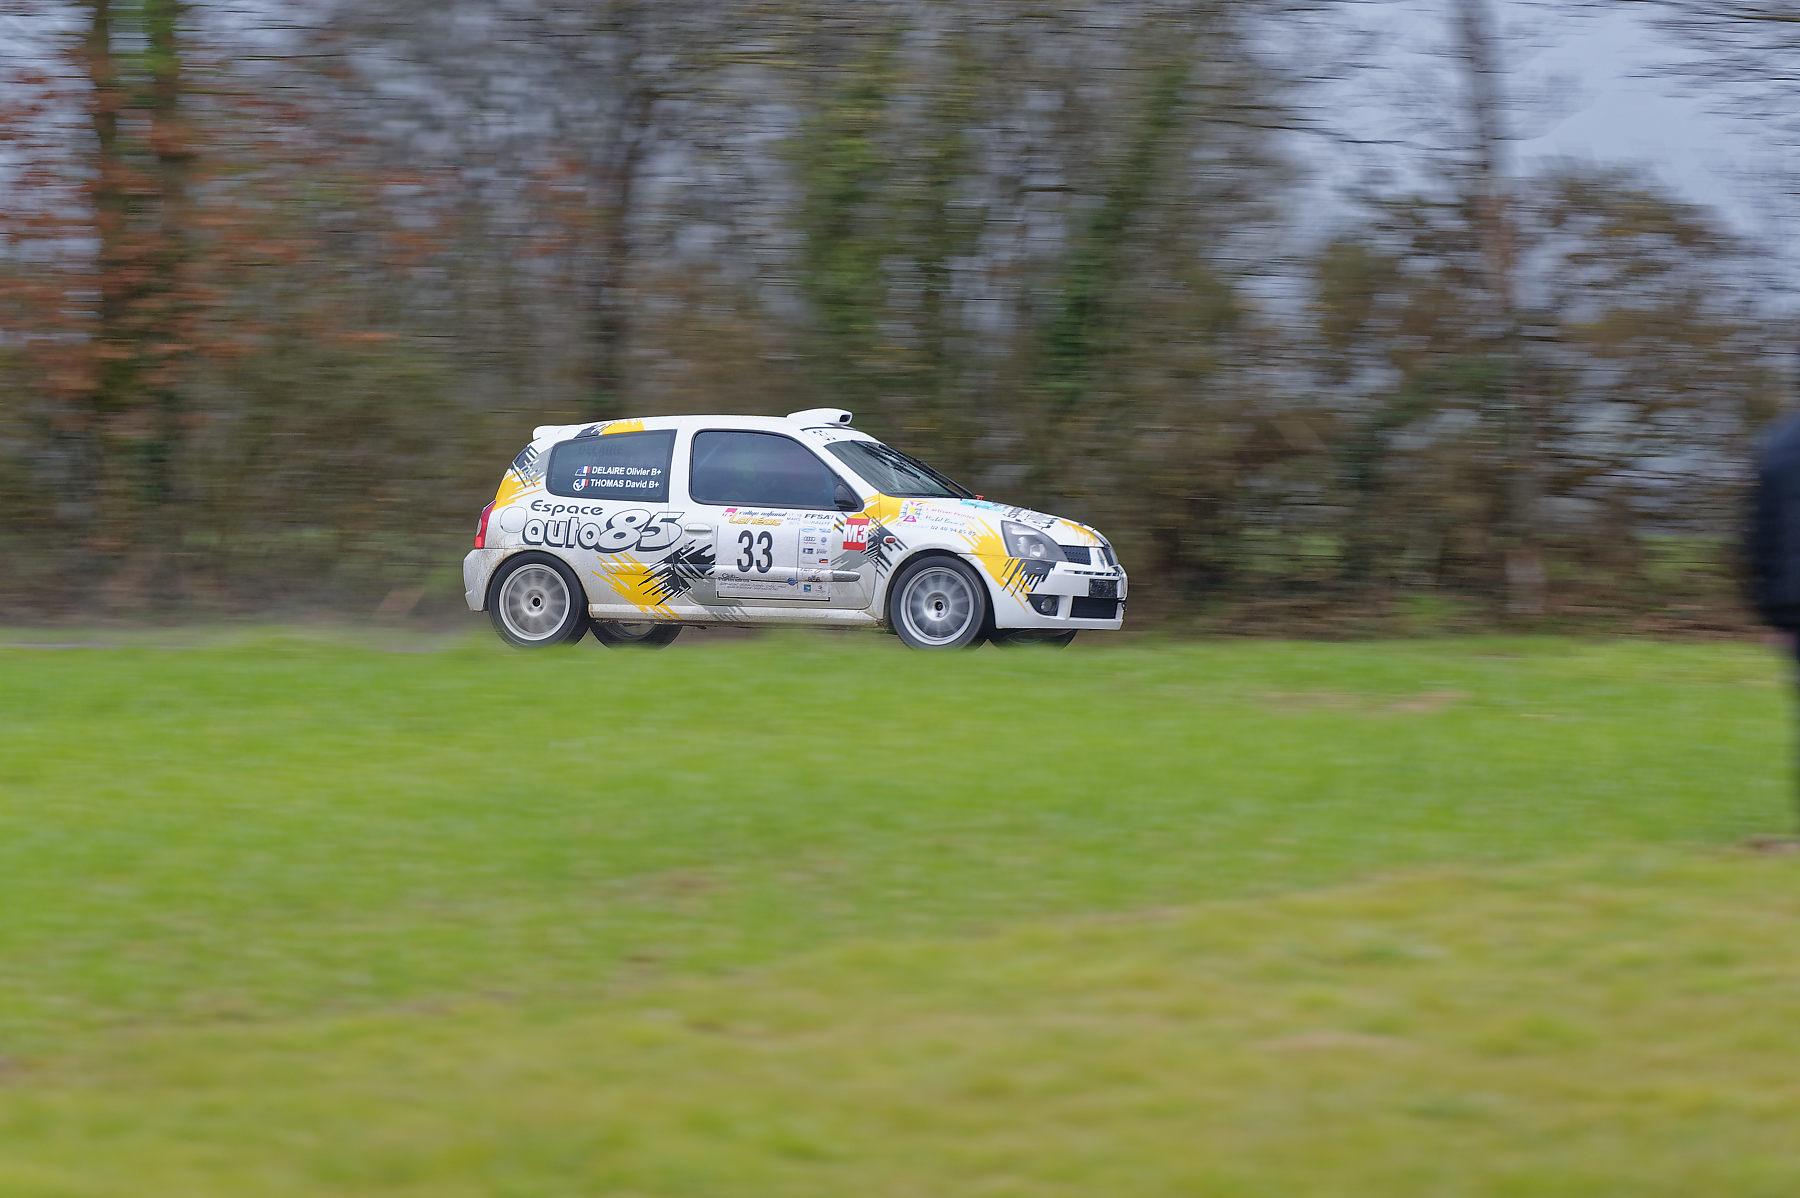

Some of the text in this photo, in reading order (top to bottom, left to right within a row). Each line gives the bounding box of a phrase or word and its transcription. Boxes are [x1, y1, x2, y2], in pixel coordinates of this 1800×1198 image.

[592, 466, 662, 476] DELAIRE Olivier B+
[590, 479, 660, 489] THOMAS David B+
[530, 499, 604, 516] Espace
[842, 524, 869, 543] M3
[736, 530, 773, 574] 33
